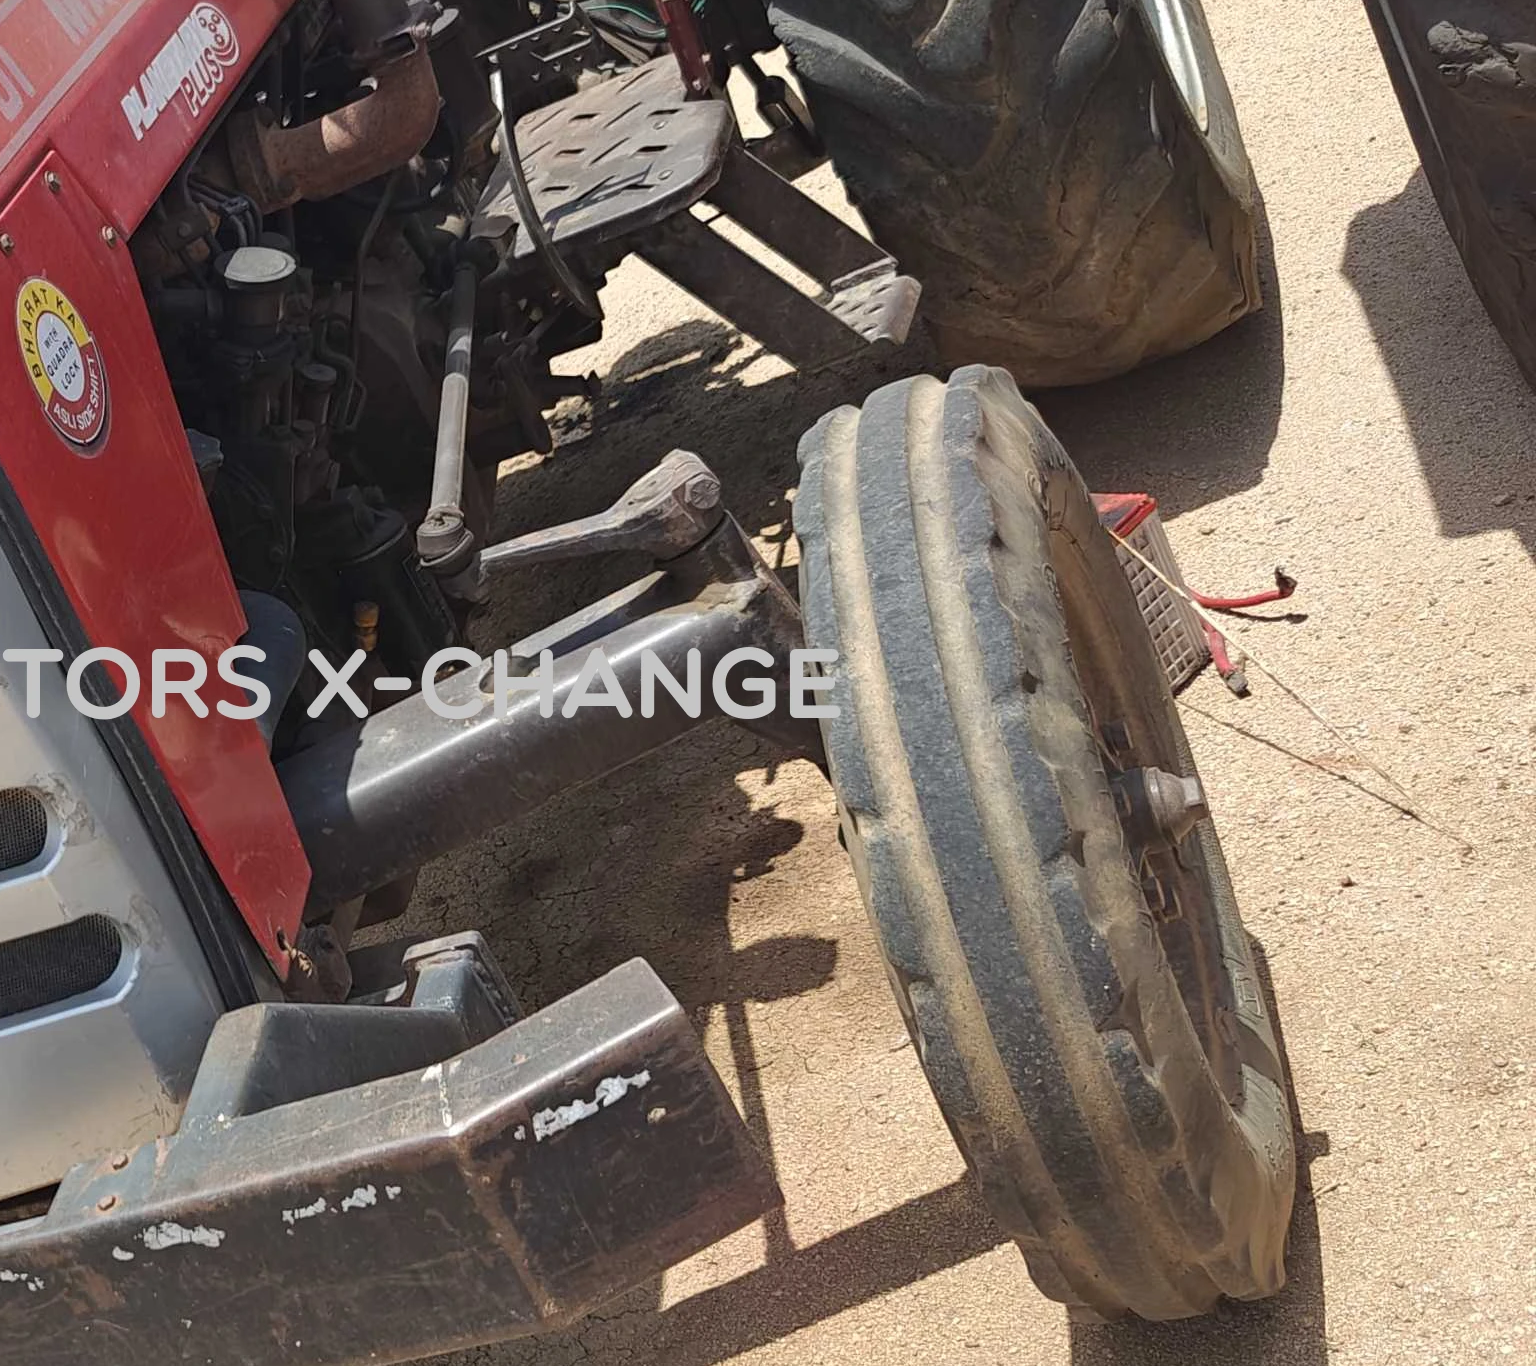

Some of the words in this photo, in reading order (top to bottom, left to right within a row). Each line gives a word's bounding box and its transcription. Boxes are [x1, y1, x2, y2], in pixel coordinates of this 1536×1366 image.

[179, 45, 224, 118] PLUS
[22, 287, 49, 378] BHARAT
[55, 295, 76, 329] KA
[44, 327, 59, 349] WITH
[46, 336, 74, 377] QUADRA
[53, 402, 77, 429] ASLI
[76, 404, 96, 430] SIDE
[86, 354, 100, 408] SHIFT
[61, 362, 81, 390] LOCK
